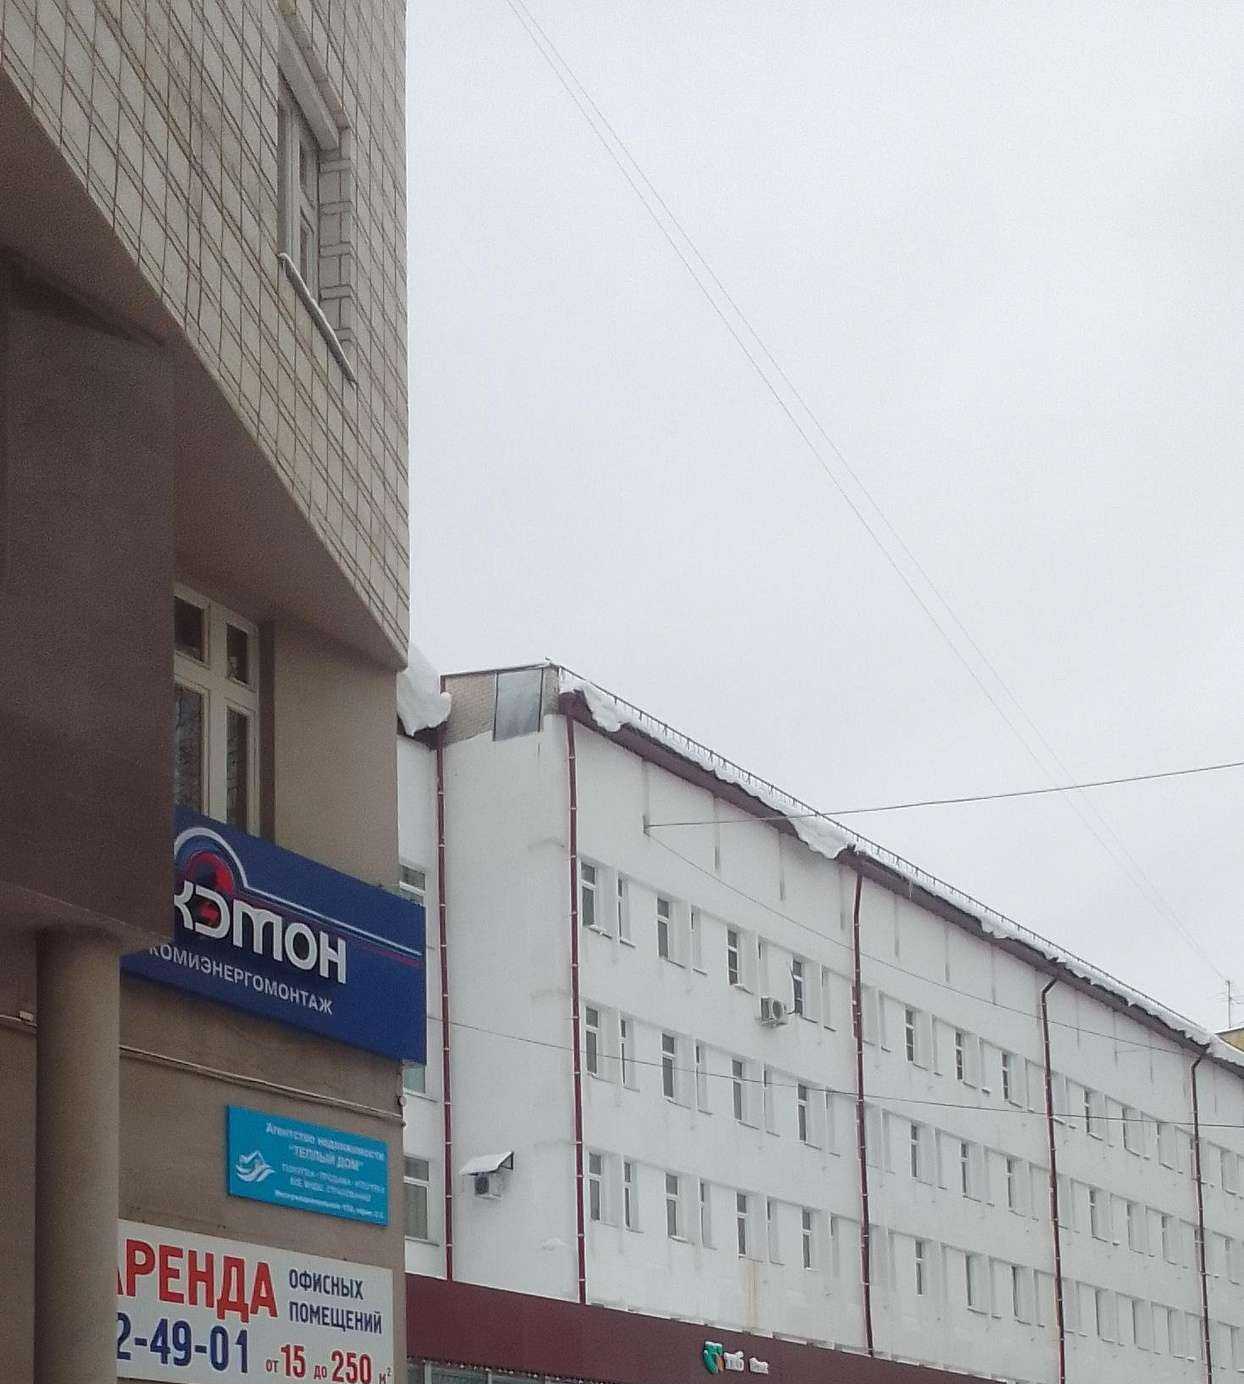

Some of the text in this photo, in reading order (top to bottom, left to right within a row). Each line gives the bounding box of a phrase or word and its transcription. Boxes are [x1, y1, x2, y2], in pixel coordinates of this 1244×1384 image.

[288, 1268, 364, 1301] ОФИСНЫХ
[288, 1300, 383, 1335] ПОМЕЩЕНИЙ
[117, 1311, 249, 1374] 2-49-01
[280, 1343, 307, 1379] 15
